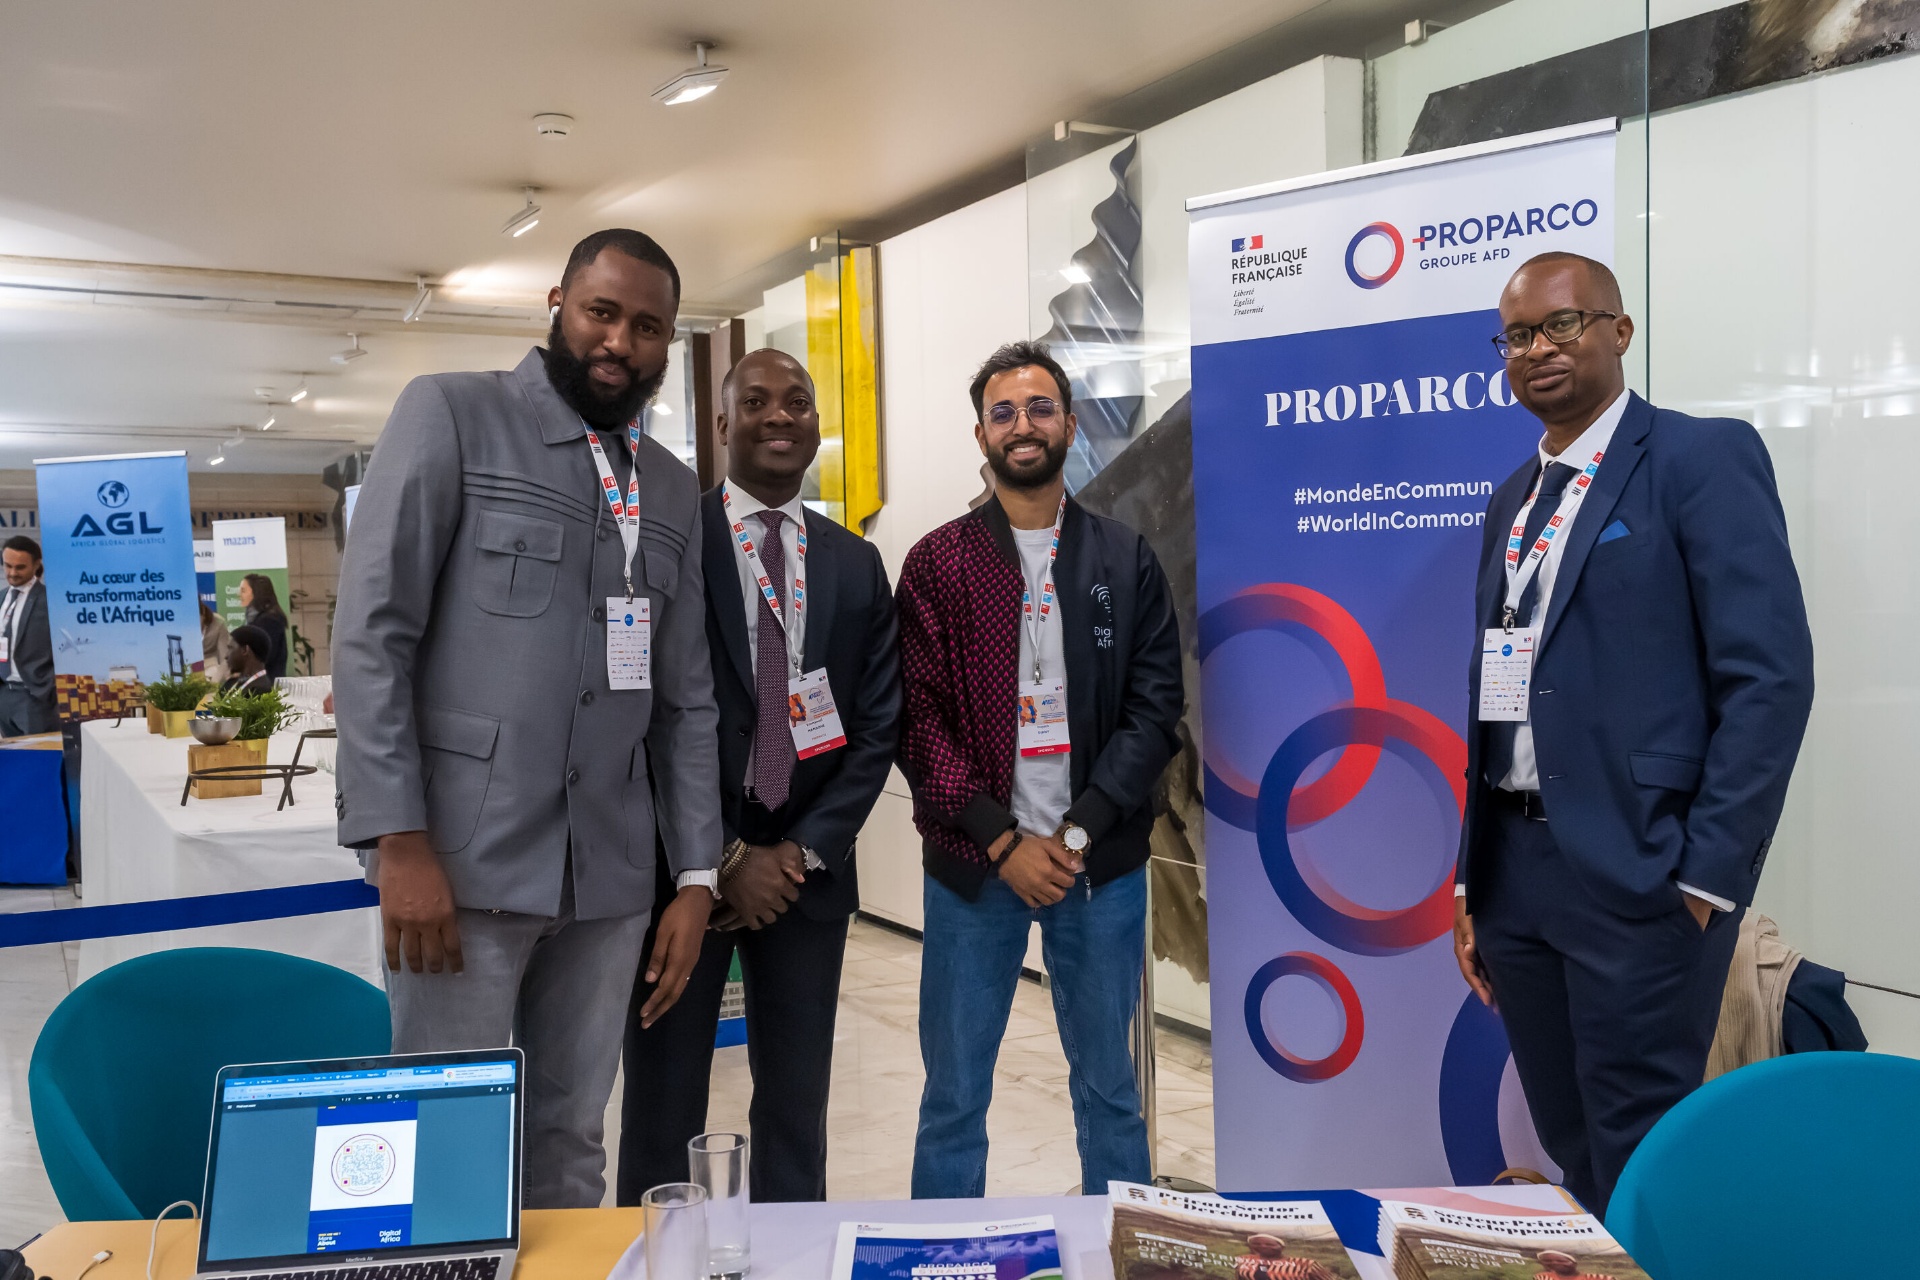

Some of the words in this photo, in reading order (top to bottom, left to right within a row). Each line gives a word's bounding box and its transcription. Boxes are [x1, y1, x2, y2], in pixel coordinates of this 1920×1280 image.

[1415, 198, 1598, 251] PROPARCO
[1231, 247, 1308, 270] RÉPUBLIQUE
[1419, 252, 1477, 270] GROUPE
[1482, 247, 1510, 262] AFD
[1232, 263, 1303, 284] FRANÇAISE
[1294, 480, 1493, 505] #MondeEnCommun
[70, 512, 164, 537] AGL
[1297, 510, 1486, 533] #WorldInCommon
[71, 540, 97, 548] AFRICA
[99, 539, 126, 547] GLOBAL
[223, 536, 256, 546] mazars
[79, 571, 99, 585] Au
[102, 572, 136, 584] cœur
[140, 569, 165, 583] des
[65, 586, 182, 603] transformations
[76, 607, 97, 624] de
[101, 605, 175, 626] l'Afrique
